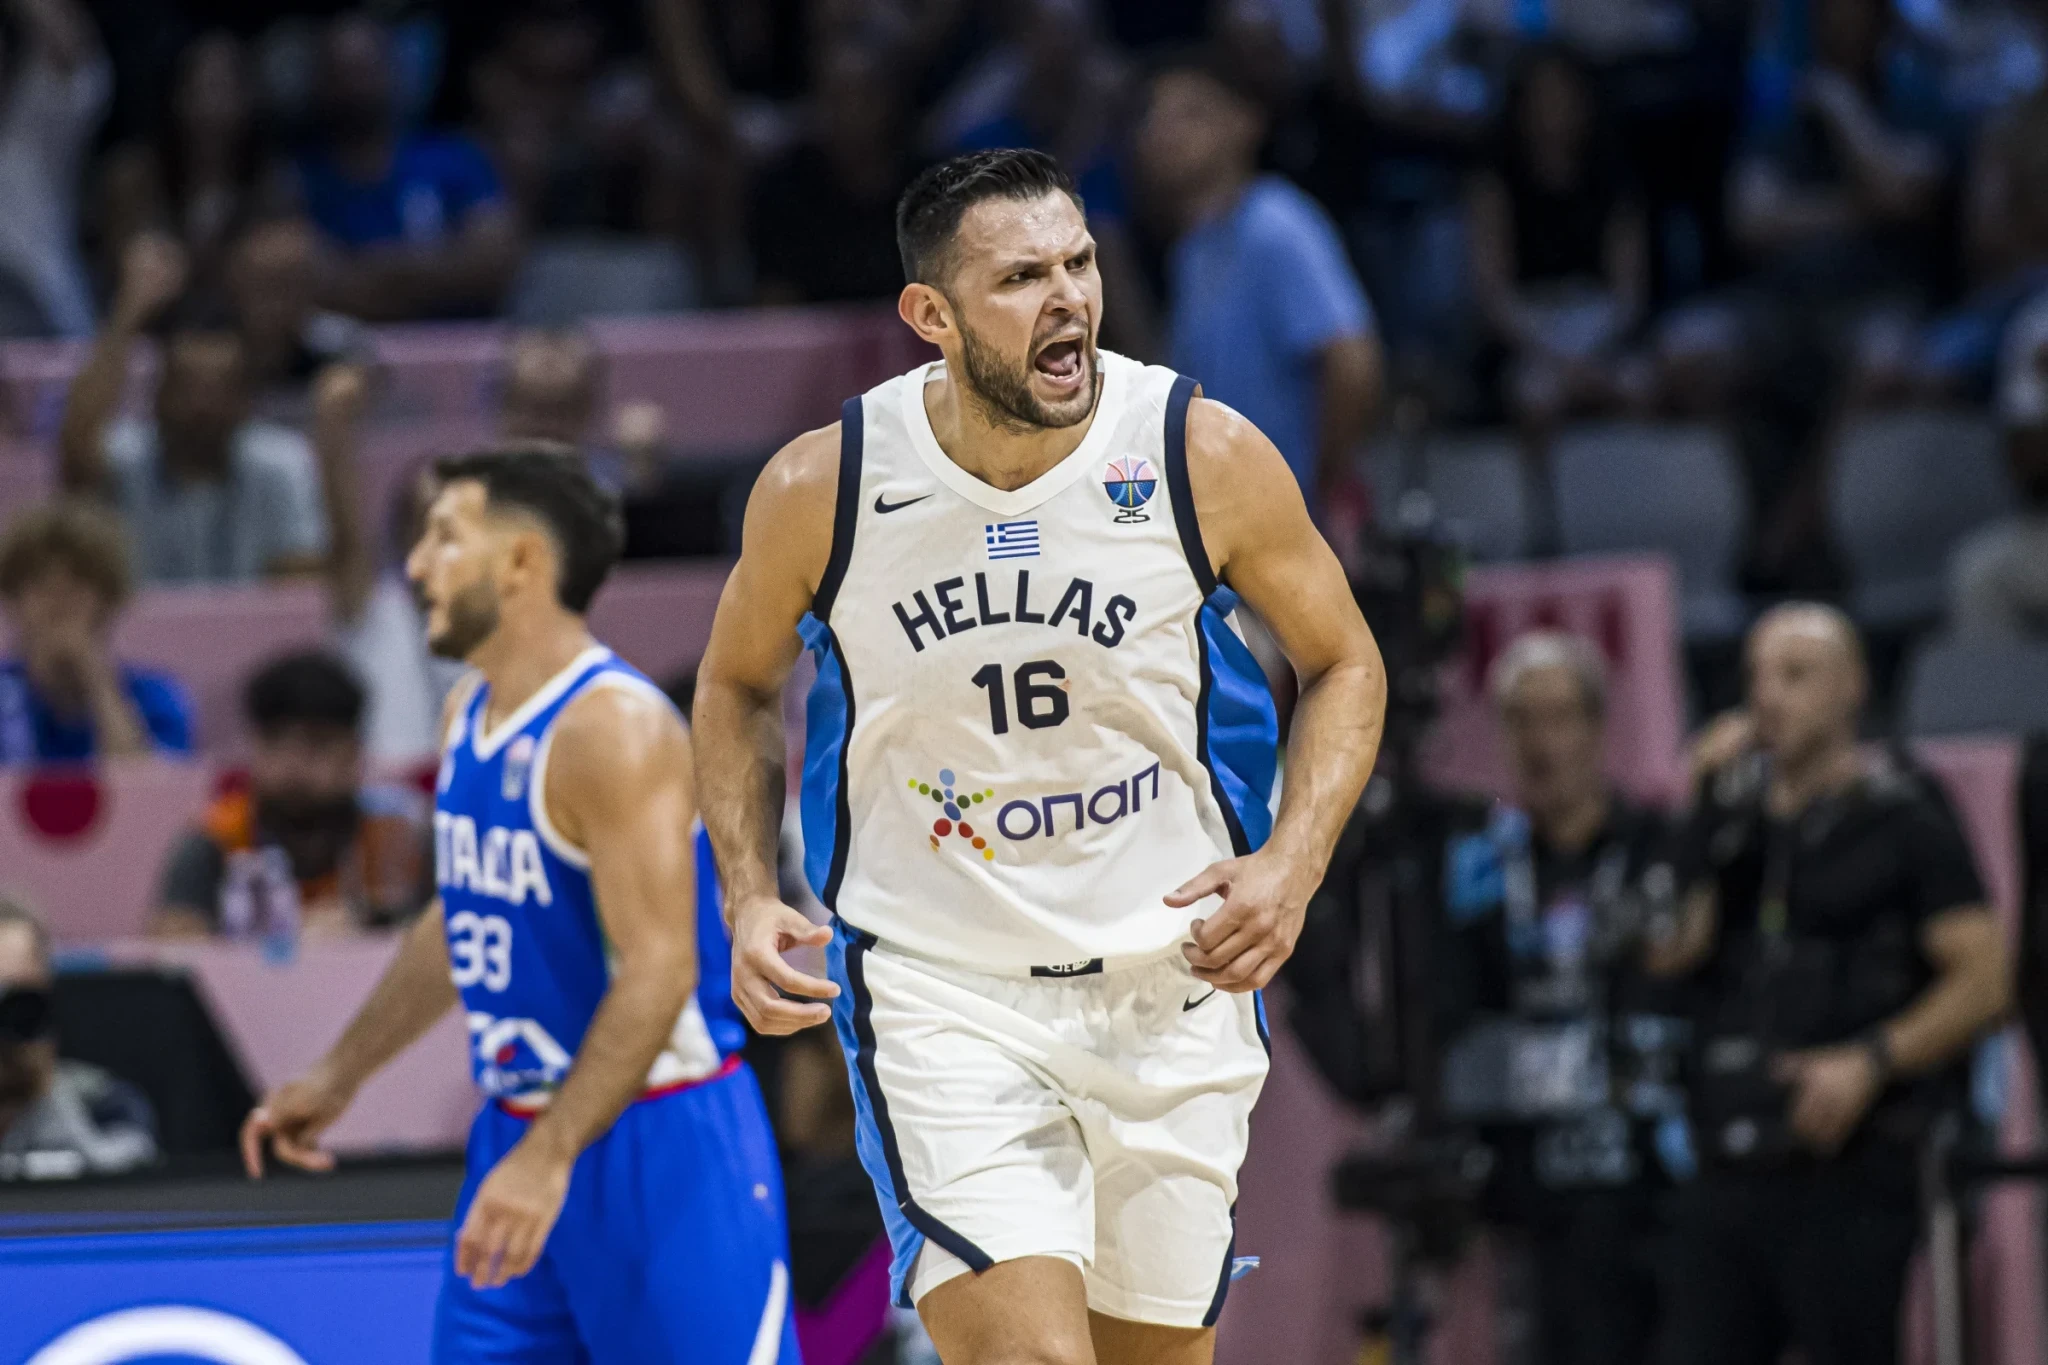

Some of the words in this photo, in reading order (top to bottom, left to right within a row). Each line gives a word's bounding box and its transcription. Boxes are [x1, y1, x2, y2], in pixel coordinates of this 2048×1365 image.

[1113, 507, 1150, 524] 25
[892, 569, 1137, 652] HELLAS
[971, 659, 1069, 735] 16
[448, 910, 513, 992] 33
